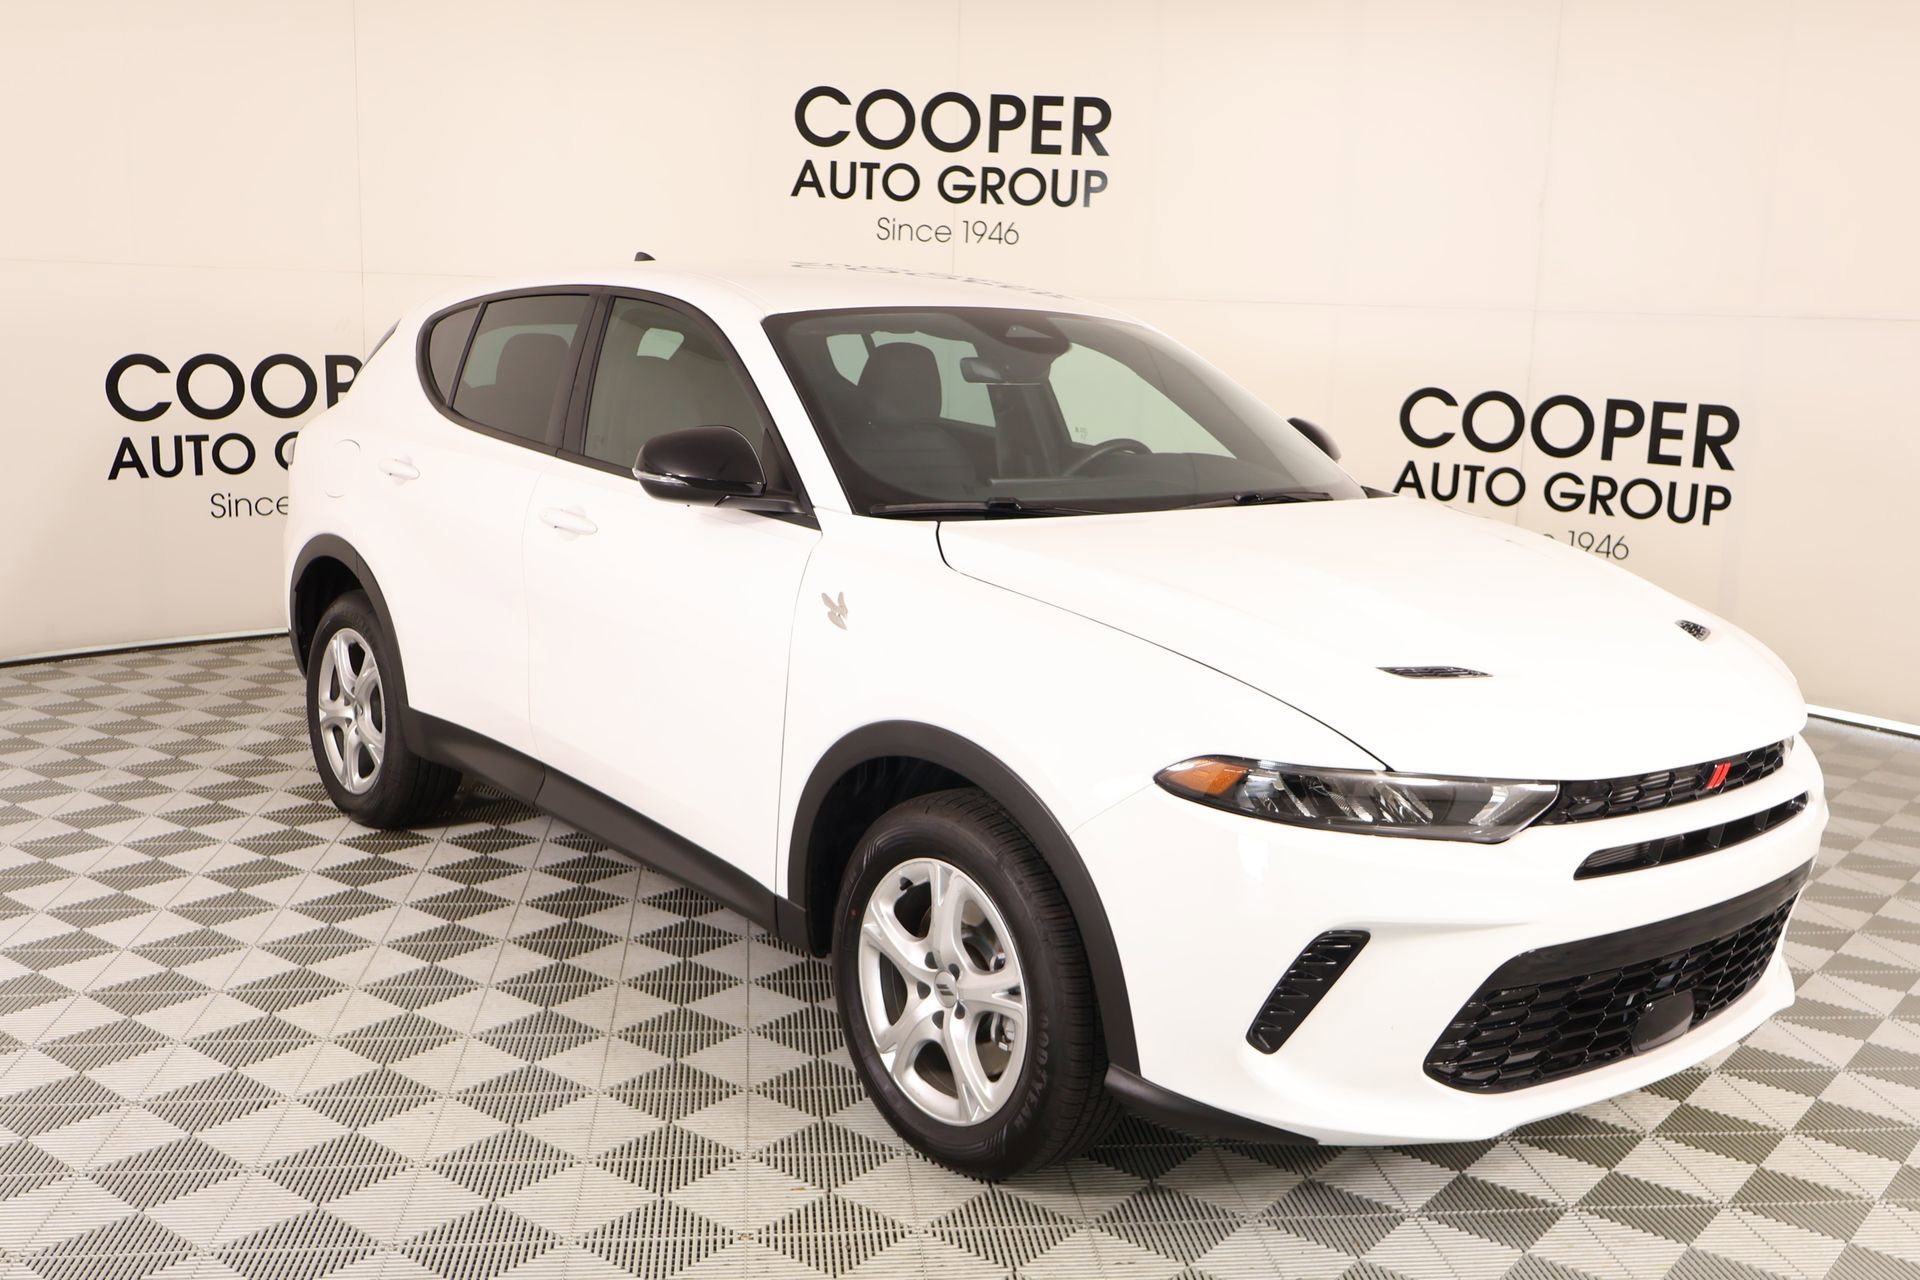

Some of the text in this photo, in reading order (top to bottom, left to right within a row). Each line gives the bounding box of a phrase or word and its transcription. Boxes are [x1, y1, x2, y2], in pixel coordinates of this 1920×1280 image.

[794, 85, 1112, 157] COOPER
[790, 159, 1109, 208] AUTO GROUP
[876, 216, 1020, 246] Since 1946
[105, 353, 365, 422] COOP
[107, 432, 256, 481] AUTO
[1399, 387, 1740, 472] COOPER
[210, 492, 289, 519] Since
[1392, 460, 1734, 527] AUTO GROUP
[1567, 529, 1630, 561] 1946
[1014, 1000, 1049, 1129] OODYEAR
